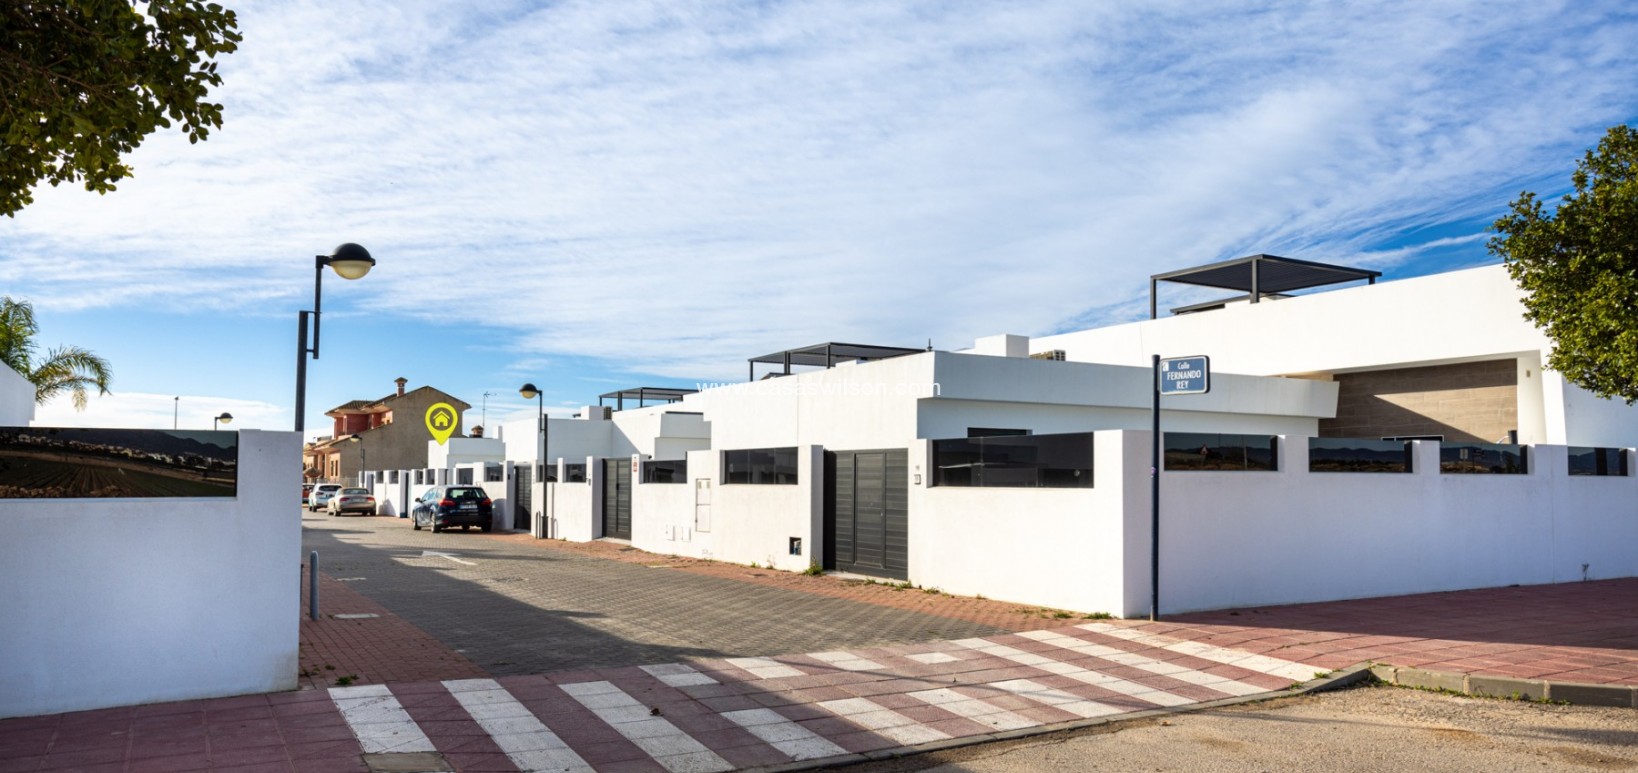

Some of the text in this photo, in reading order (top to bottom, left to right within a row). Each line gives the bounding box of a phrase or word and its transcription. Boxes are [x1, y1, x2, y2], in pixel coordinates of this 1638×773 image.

[1177, 361, 1190, 369] Calle
[1167, 369, 1201, 380] FERNANDO
[1176, 380, 1189, 389] REY
